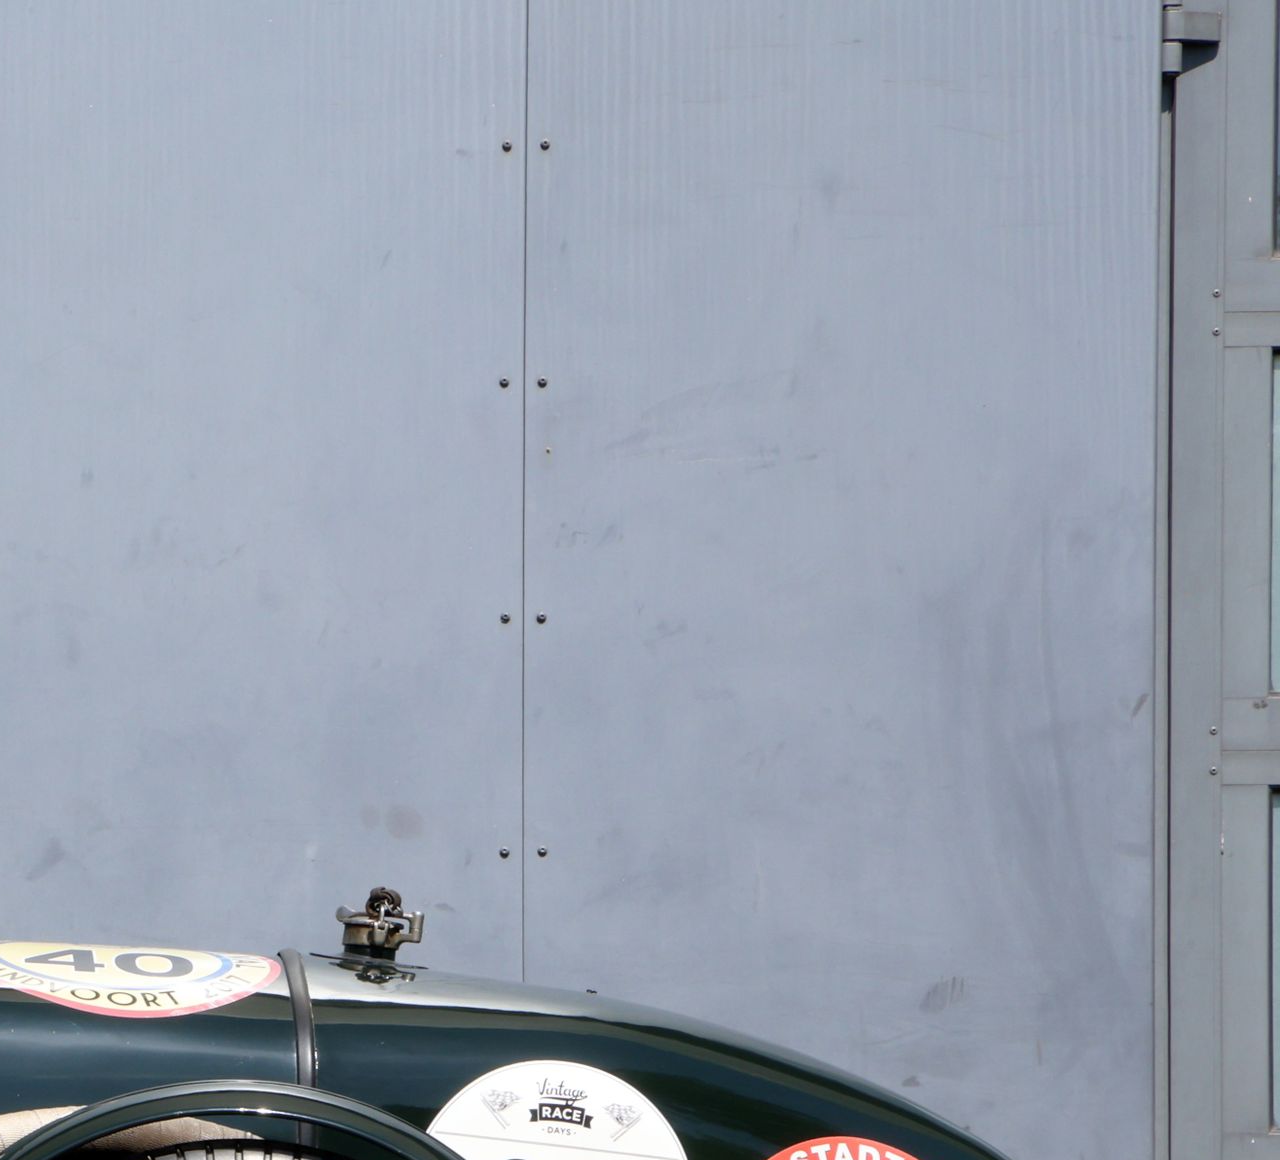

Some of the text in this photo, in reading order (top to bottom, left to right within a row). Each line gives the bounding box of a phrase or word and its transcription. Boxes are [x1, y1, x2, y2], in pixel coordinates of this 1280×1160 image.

[24, 948, 194, 978] 40
[536, 1078, 588, 1105] Vintage
[541, 1106, 583, 1122] RACE
[546, 1126, 572, 1136] DAYS
